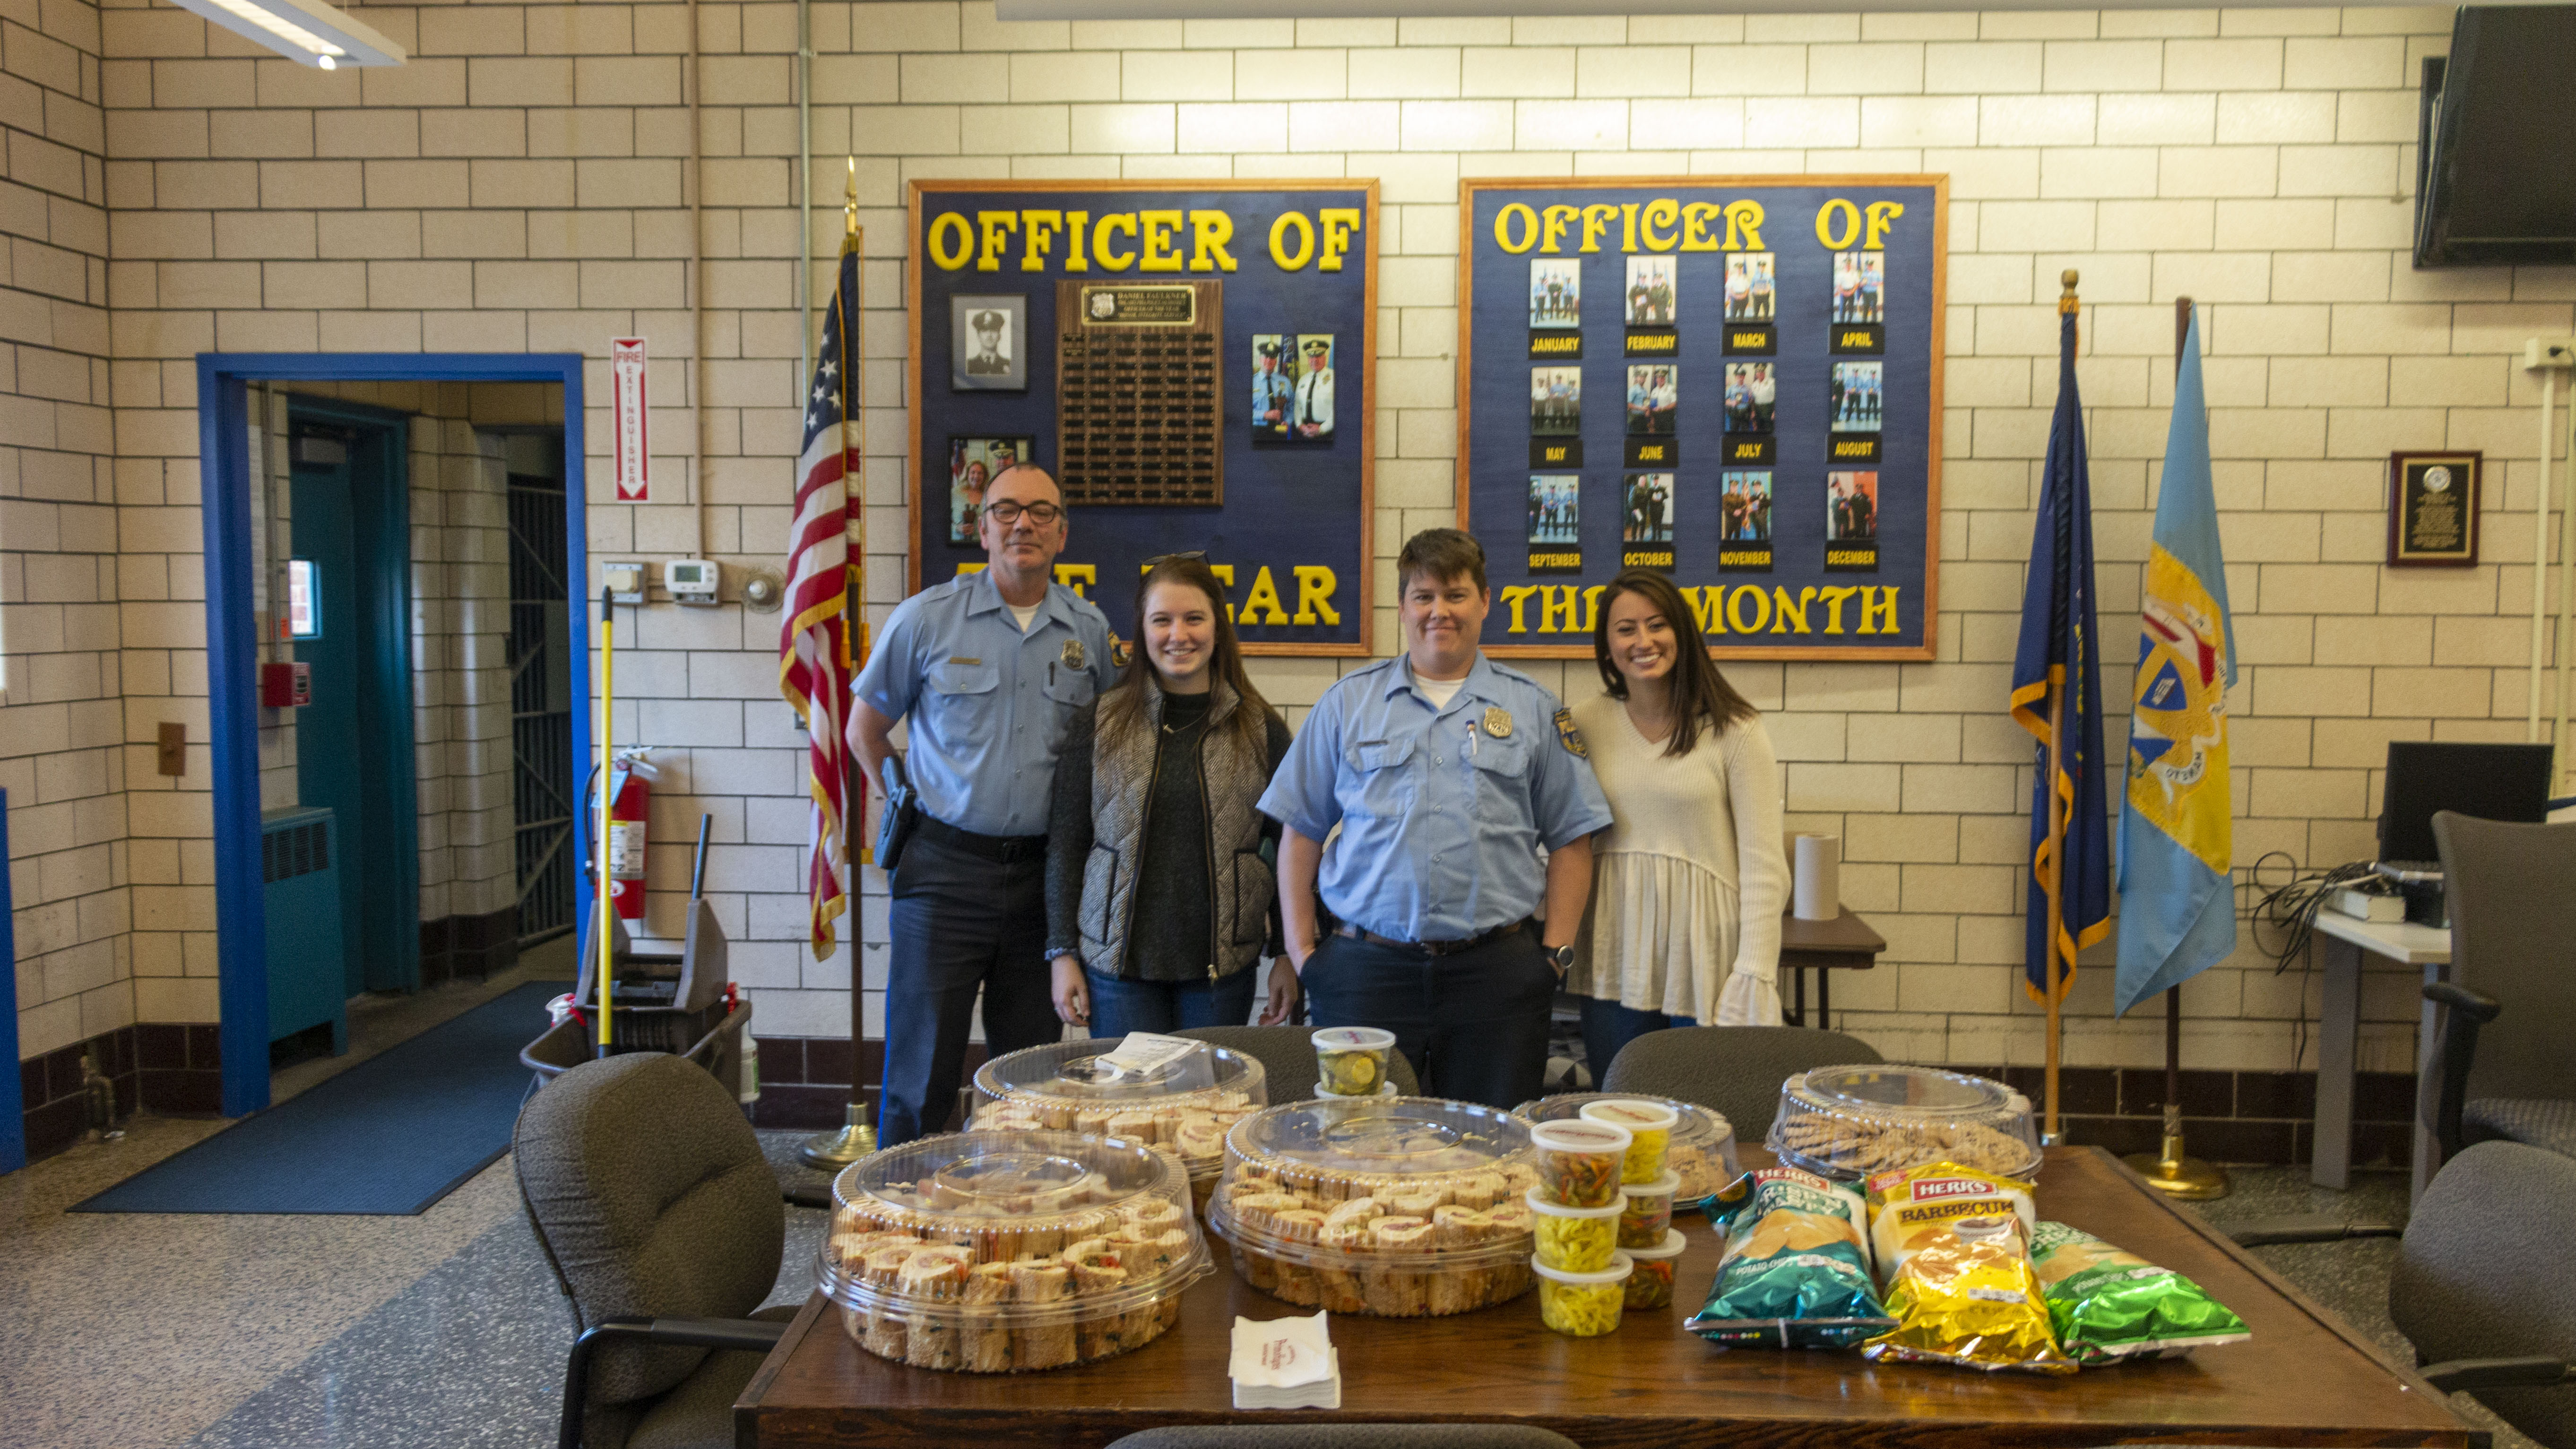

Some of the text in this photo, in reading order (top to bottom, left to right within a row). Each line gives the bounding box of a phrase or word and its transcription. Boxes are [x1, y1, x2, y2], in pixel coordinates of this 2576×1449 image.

[1494, 198, 1904, 254] OFFICER OF
[928, 207, 1360, 271] OFFICER OF
[1531, 337, 1580, 353] JANUARY
[1627, 335, 1676, 351] FEBRUARY
[1733, 333, 1766, 348] MARCH
[1841, 332, 1873, 347] APRIL
[616, 352, 642, 363] FIRE
[625, 366, 635, 483] EXTINGUISHER
[1546, 447, 1566, 461] MAY
[1639, 446, 1663, 460] JUNE
[1735, 443, 1762, 458] JULY
[1835, 441, 1874, 456] AUGUST
[1529, 553, 1581, 567] SEPTEMBER
[1624, 552, 1673, 566] OCTOBER
[1720, 551, 1771, 565] NOVEMBER
[1827, 551, 1875, 564] DECEMBER
[1678, 584, 1901, 635] MONTH
[1736, 1261, 1767, 1276] POTATO
